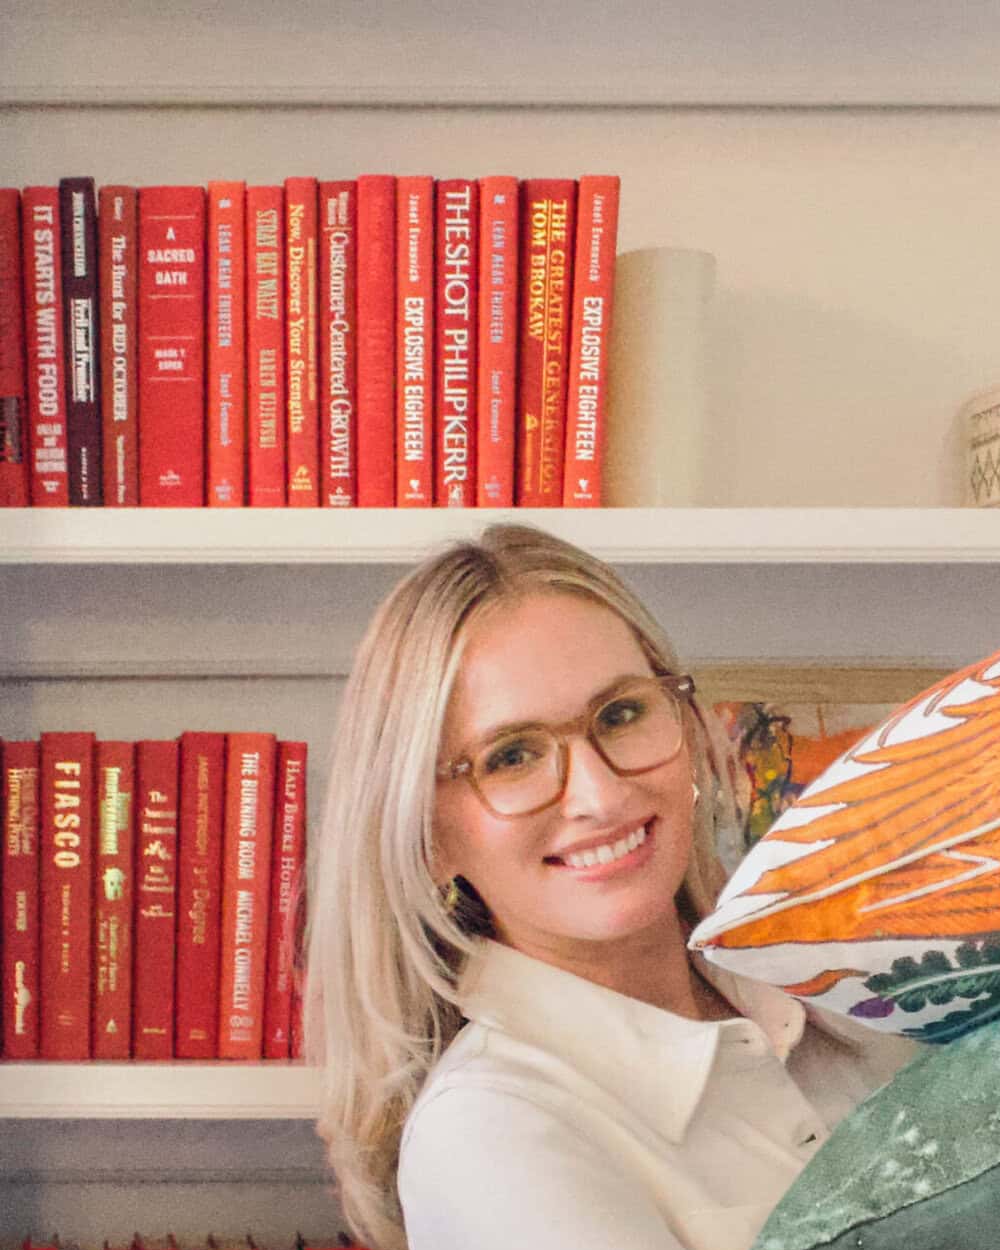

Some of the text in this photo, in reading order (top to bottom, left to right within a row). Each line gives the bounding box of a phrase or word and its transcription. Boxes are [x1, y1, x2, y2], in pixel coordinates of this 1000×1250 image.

[33, 206, 53, 223] IT
[167, 227, 175, 241] A
[408, 194, 420, 281] Janet Evanovich
[551, 200, 567, 241] THE
[592, 194, 604, 223] Janet
[34, 229, 56, 303] STARTS
[148, 249, 195, 263] SACRED
[156, 271, 187, 285] OATH
[256, 208, 278, 319] STRAY KAT WALTZ
[528, 200, 547, 341] TOM BROKAW
[36, 309, 57, 358] WITH
[112, 236, 128, 421] The Hunt for RED OCTOBER
[289, 204, 305, 433] Now, Discover Your Strengths
[330, 232, 349, 394] Customer-Centered
[443, 186, 470, 485] THE SHOT PHILIP KERR
[547, 251, 566, 351] GREATEST
[38, 364, 58, 415] FOOD
[404, 297, 424, 460] EXPLOSIVE EIGHTEEN
[575, 297, 603, 460] EXPLOSIVE EIGHTEEN
[330, 400, 351, 478] GROWTH
[53, 762, 81, 868] FIASCO
[238, 752, 260, 879] THE BURNING ROOM
[285, 760, 301, 797] HALF
[281, 803, 299, 853] BROKE
[233, 890, 255, 1010] MICHAEL CONNELLY
